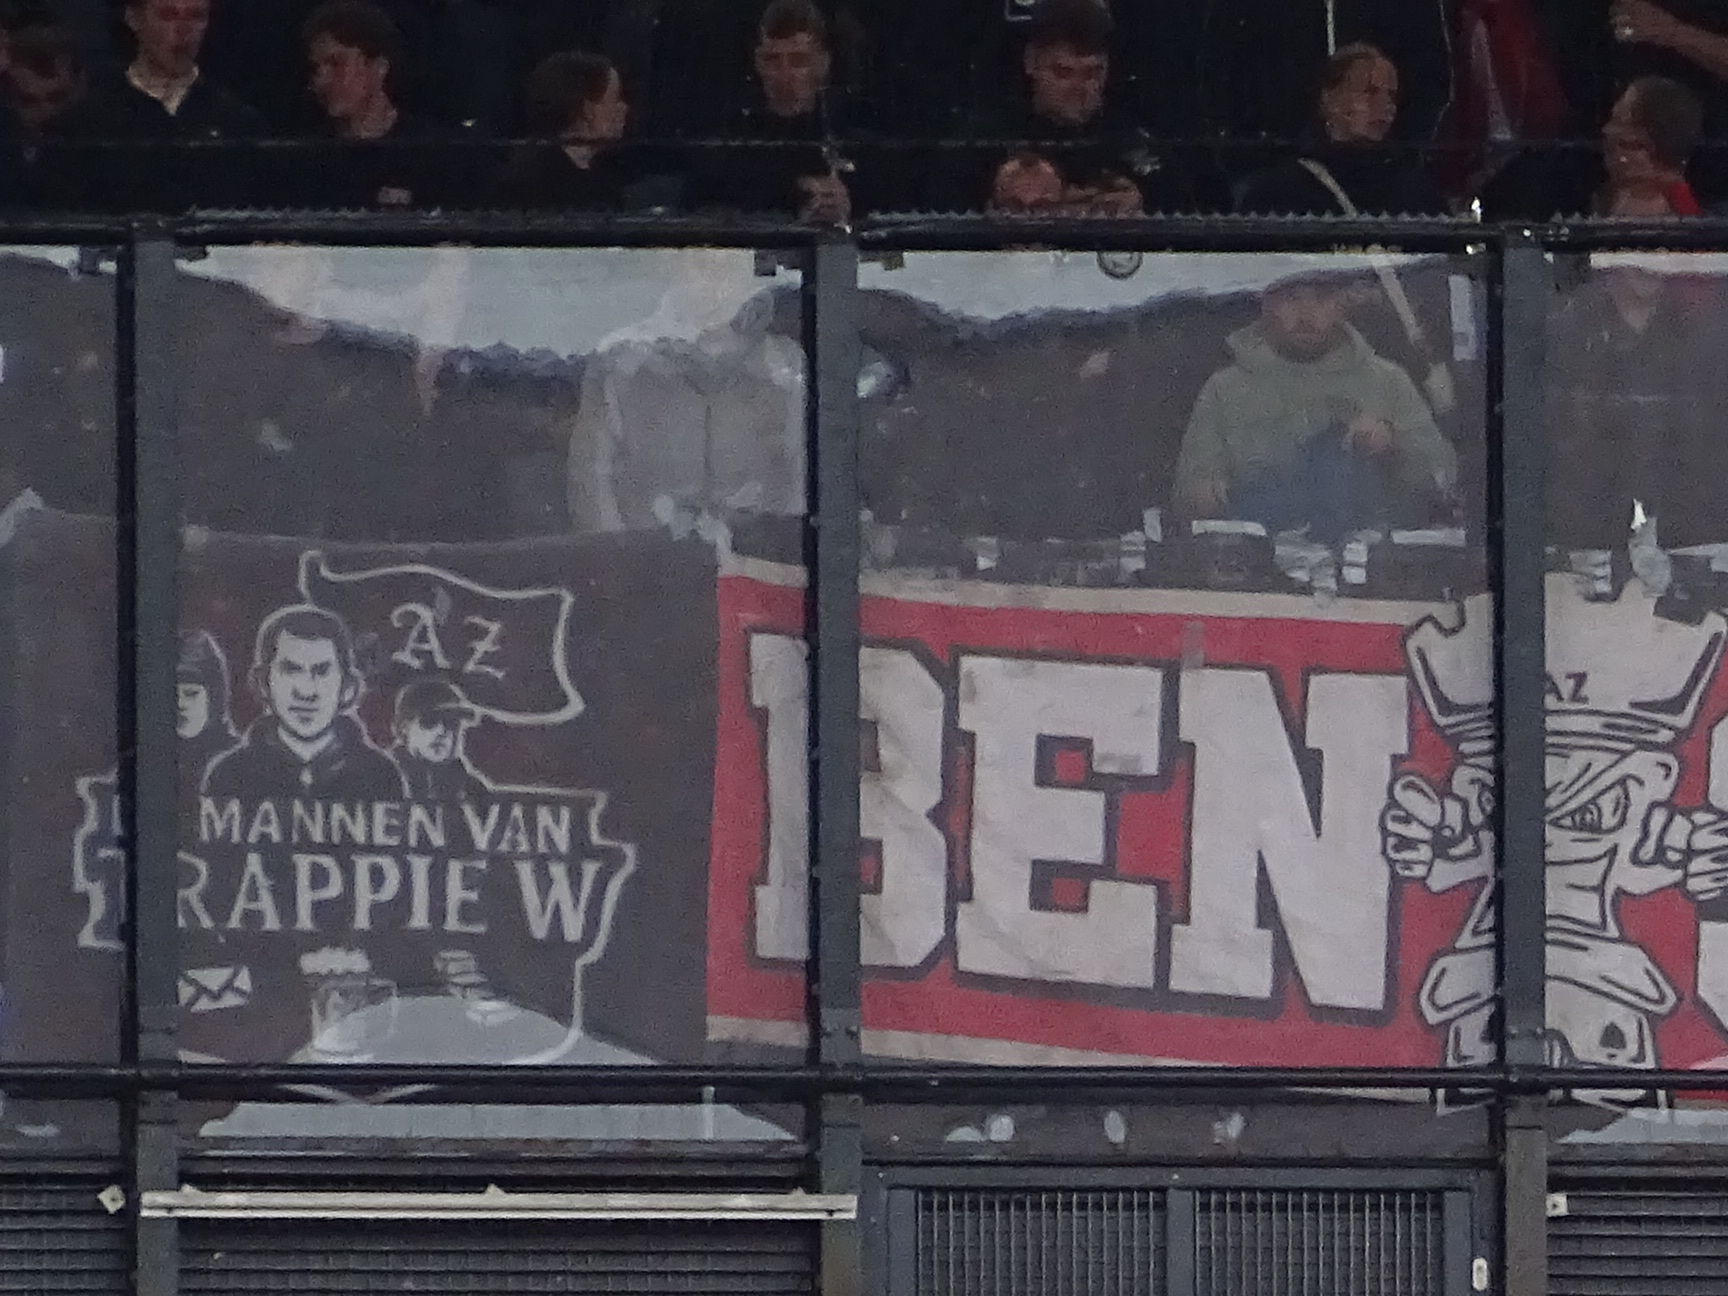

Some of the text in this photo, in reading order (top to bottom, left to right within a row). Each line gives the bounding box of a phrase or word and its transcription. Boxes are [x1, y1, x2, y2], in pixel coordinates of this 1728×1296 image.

[391, 601, 510, 679] AZ
[201, 795, 571, 854] MANNEN VAN
[747, 633, 1408, 1010] BEN
[517, 860, 600, 942] W
